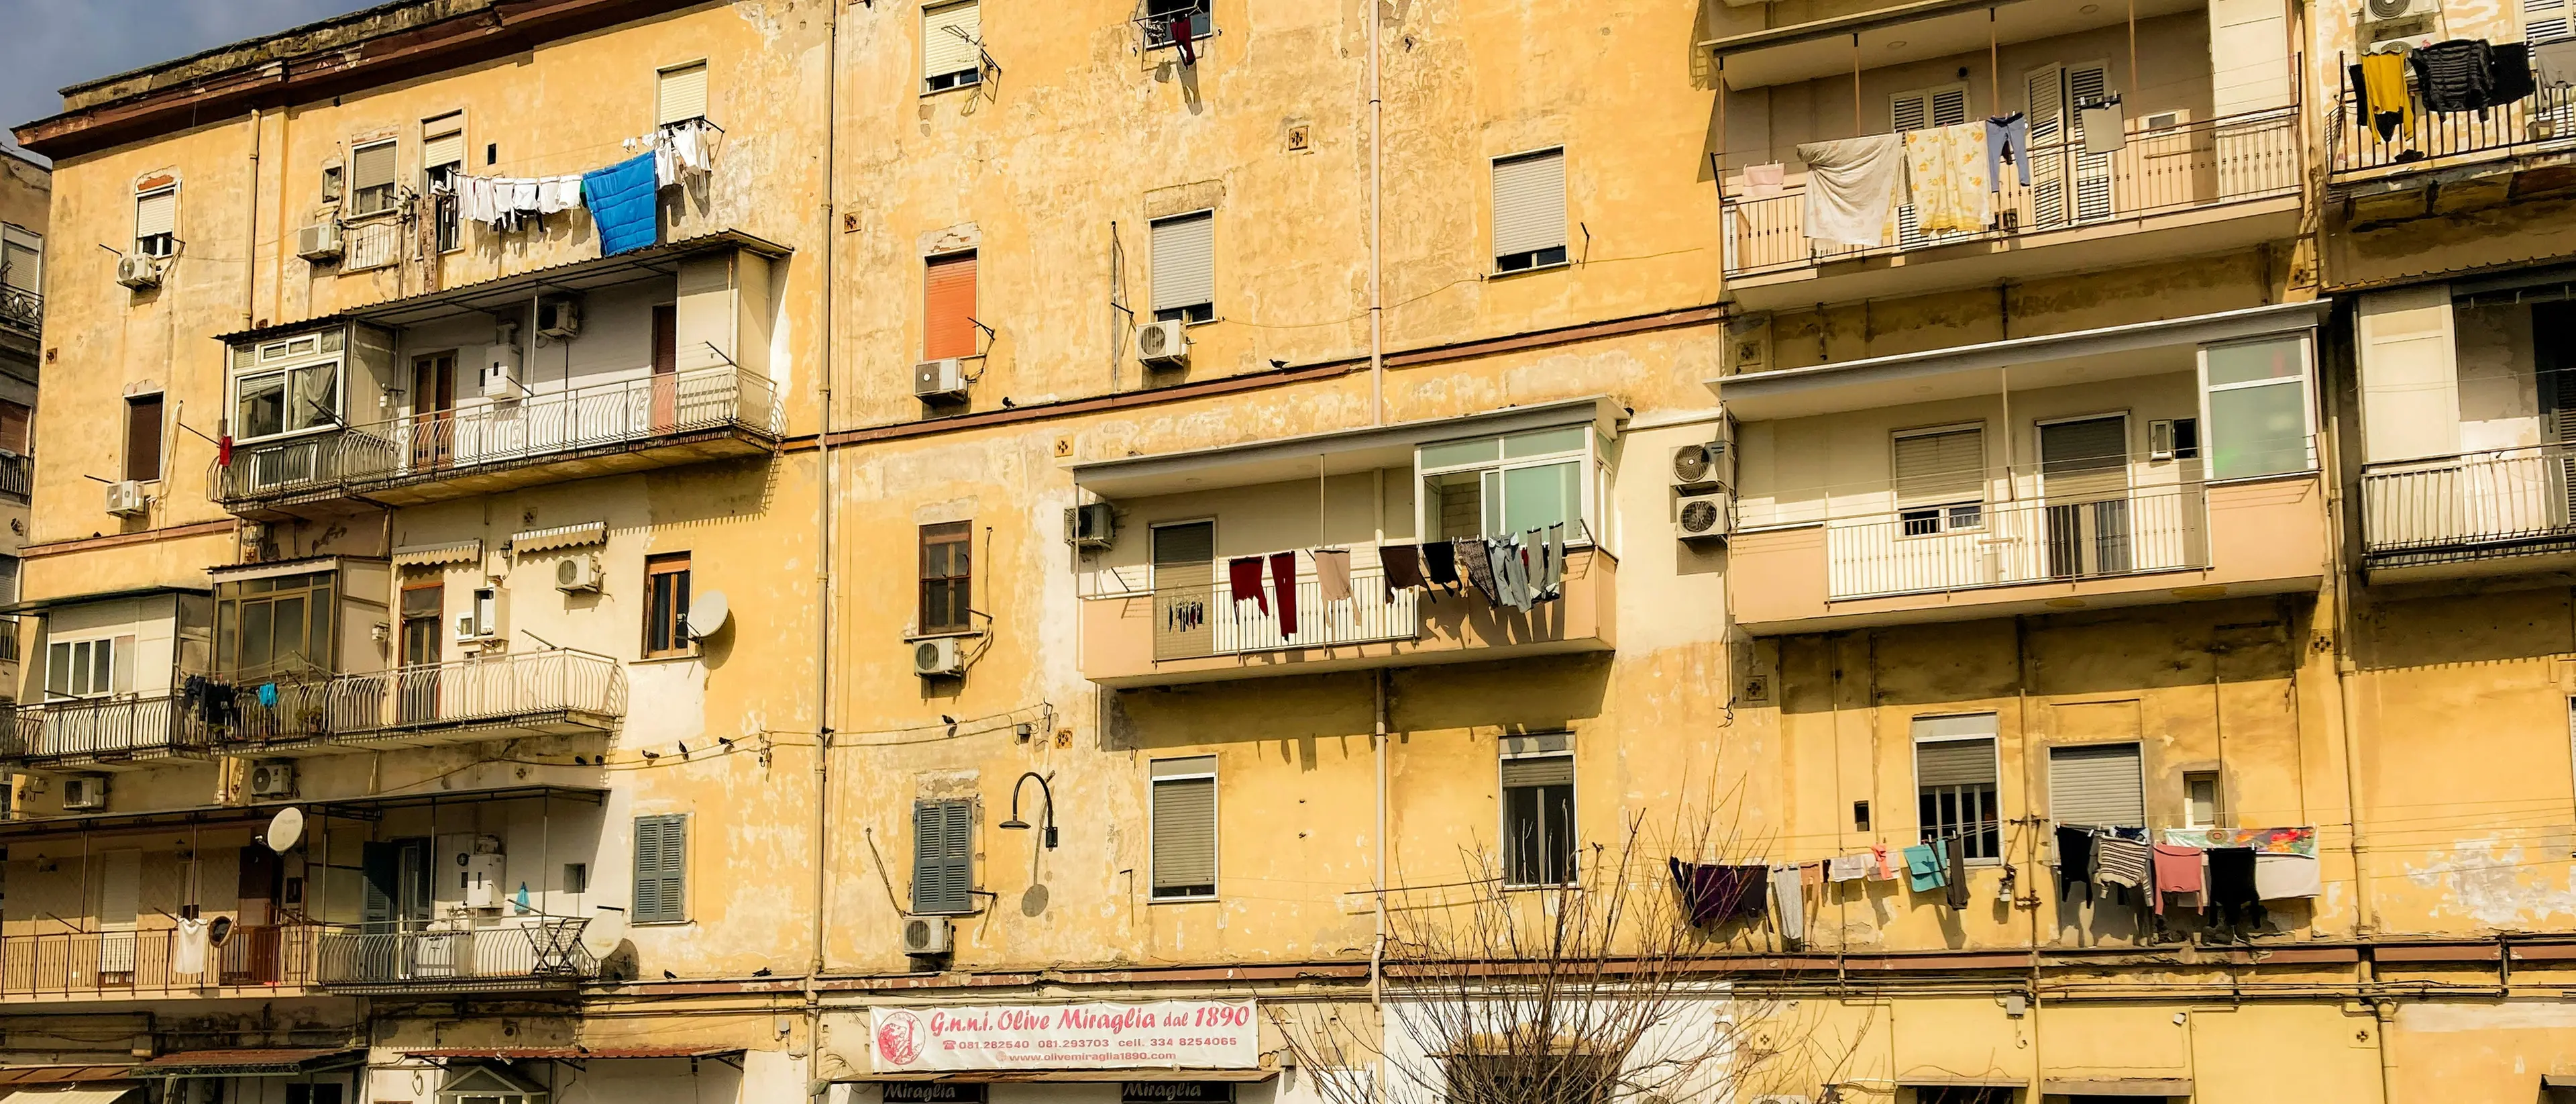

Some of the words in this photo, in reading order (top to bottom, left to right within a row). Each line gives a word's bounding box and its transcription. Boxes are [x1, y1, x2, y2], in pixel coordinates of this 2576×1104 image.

[998, 1009, 1050, 1031] Olive
[1057, 1007, 1155, 1035] Miraglia
[1163, 1011, 1188, 1027] dal
[1195, 1006, 1250, 1027] 1890
[959, 1040, 1030, 1050] 081.282540
[1038, 1038, 1110, 1048] 081.293703
[1118, 1038, 1144, 1047] cell.
[1150, 1038, 1173, 1046] 334
[1179, 1037, 1237, 1046] 8254065
[1009, 1052, 1176, 1062] www.olivemiraglia1890.com
[884, 1083, 955, 1103] Miraglia
[1123, 1082, 1201, 1101] Miraglia
